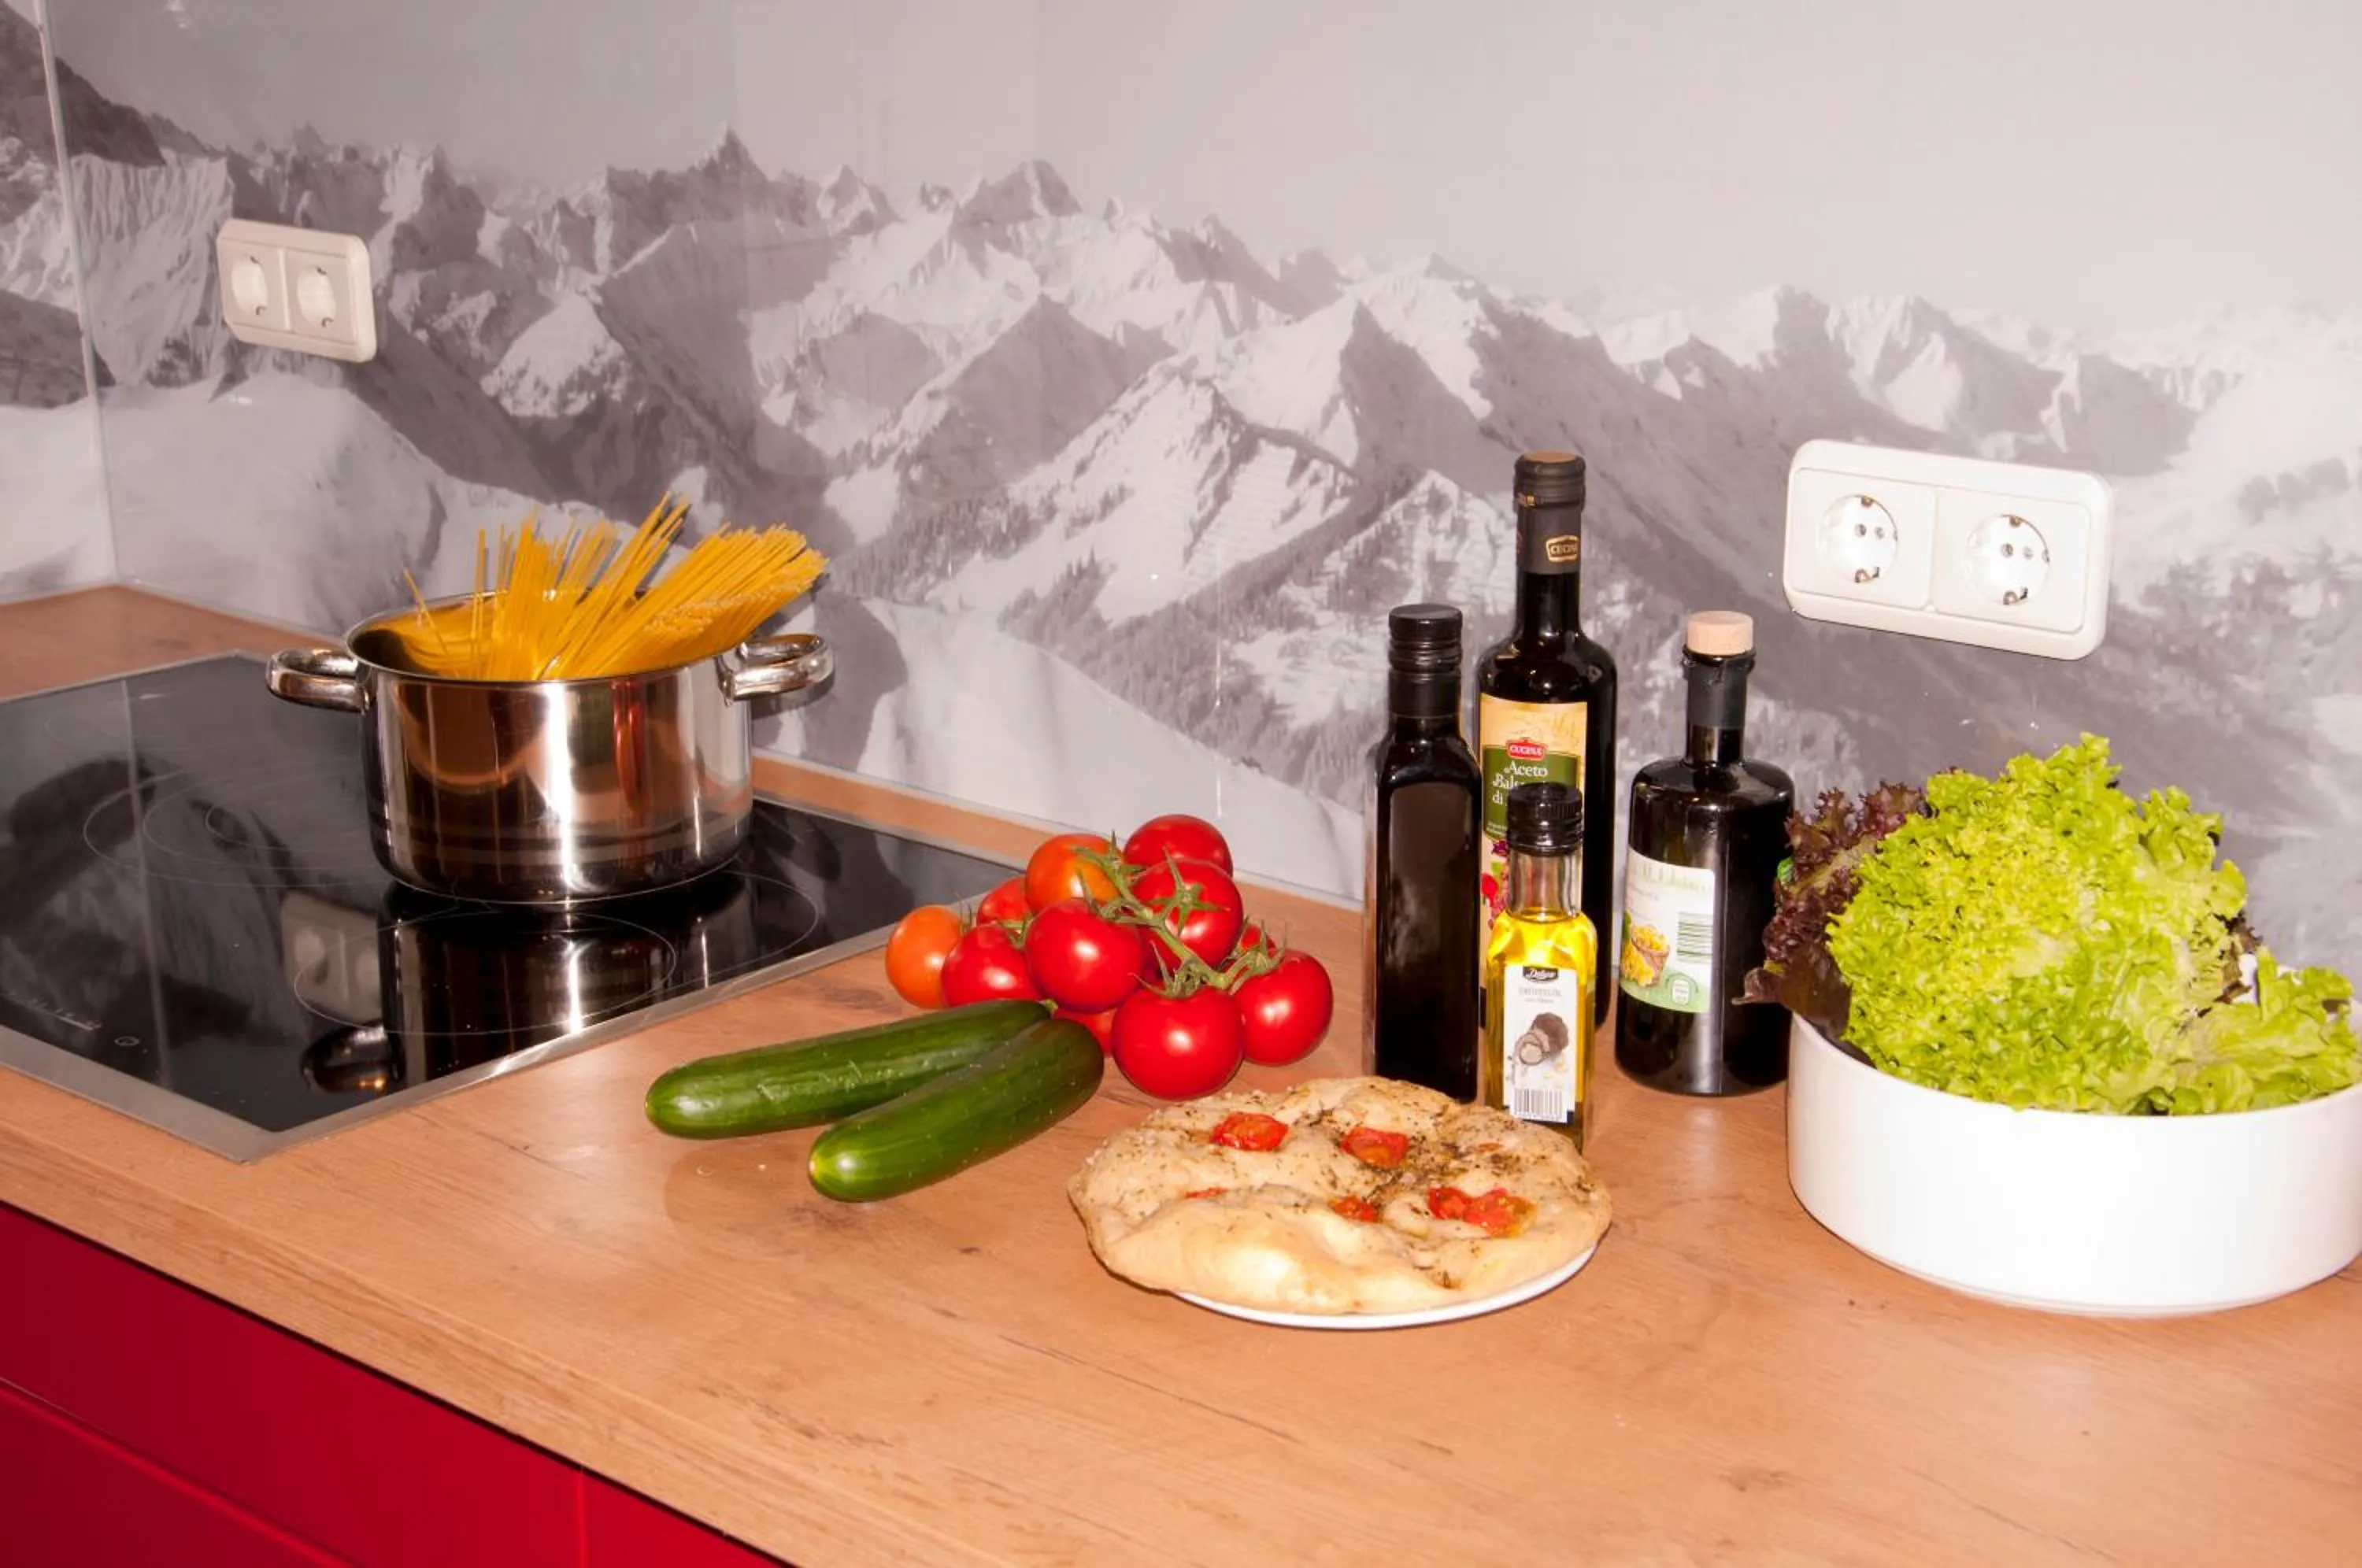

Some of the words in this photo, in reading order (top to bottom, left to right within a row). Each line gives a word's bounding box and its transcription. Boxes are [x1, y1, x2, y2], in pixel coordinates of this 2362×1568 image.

[1510, 745, 1543, 756] CUCINA
[1504, 760, 1548, 776] Aceto
[1492, 790, 1503, 804] di
